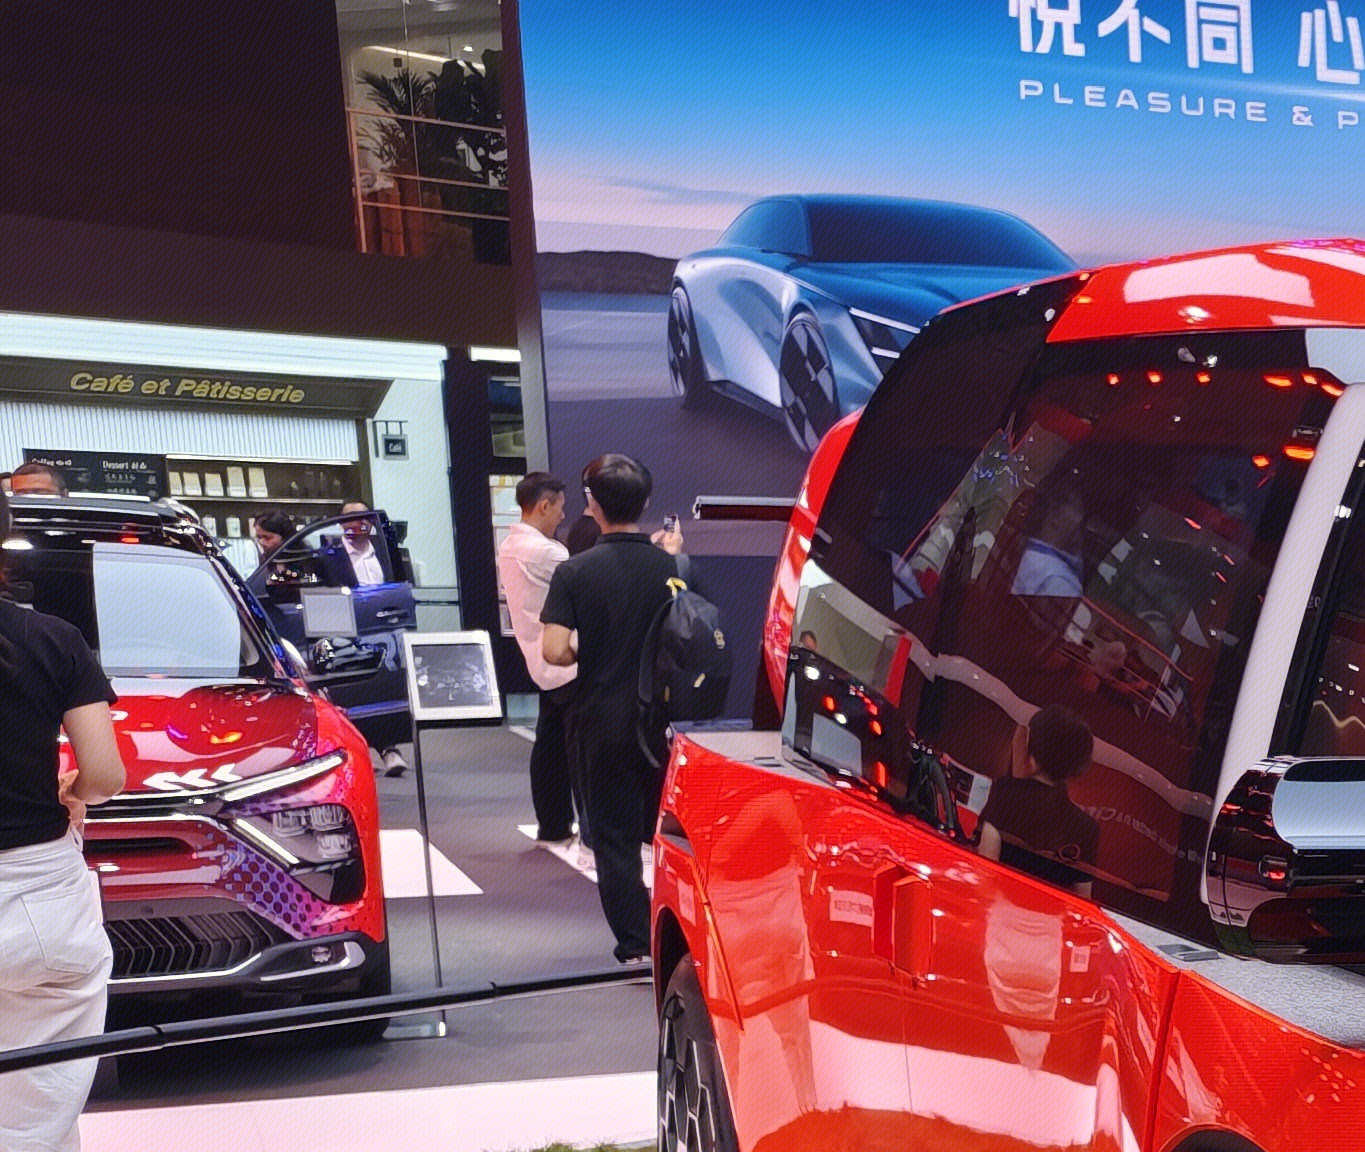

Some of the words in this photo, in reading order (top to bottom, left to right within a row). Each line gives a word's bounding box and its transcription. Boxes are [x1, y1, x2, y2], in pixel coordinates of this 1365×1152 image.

[1019, 79, 1268, 122] PLEASURE
[1292, 106, 1314, 127] &
[70, 372, 135, 393] Café
[141, 378, 171, 395] et
[175, 378, 305, 403] Pâtisserie
